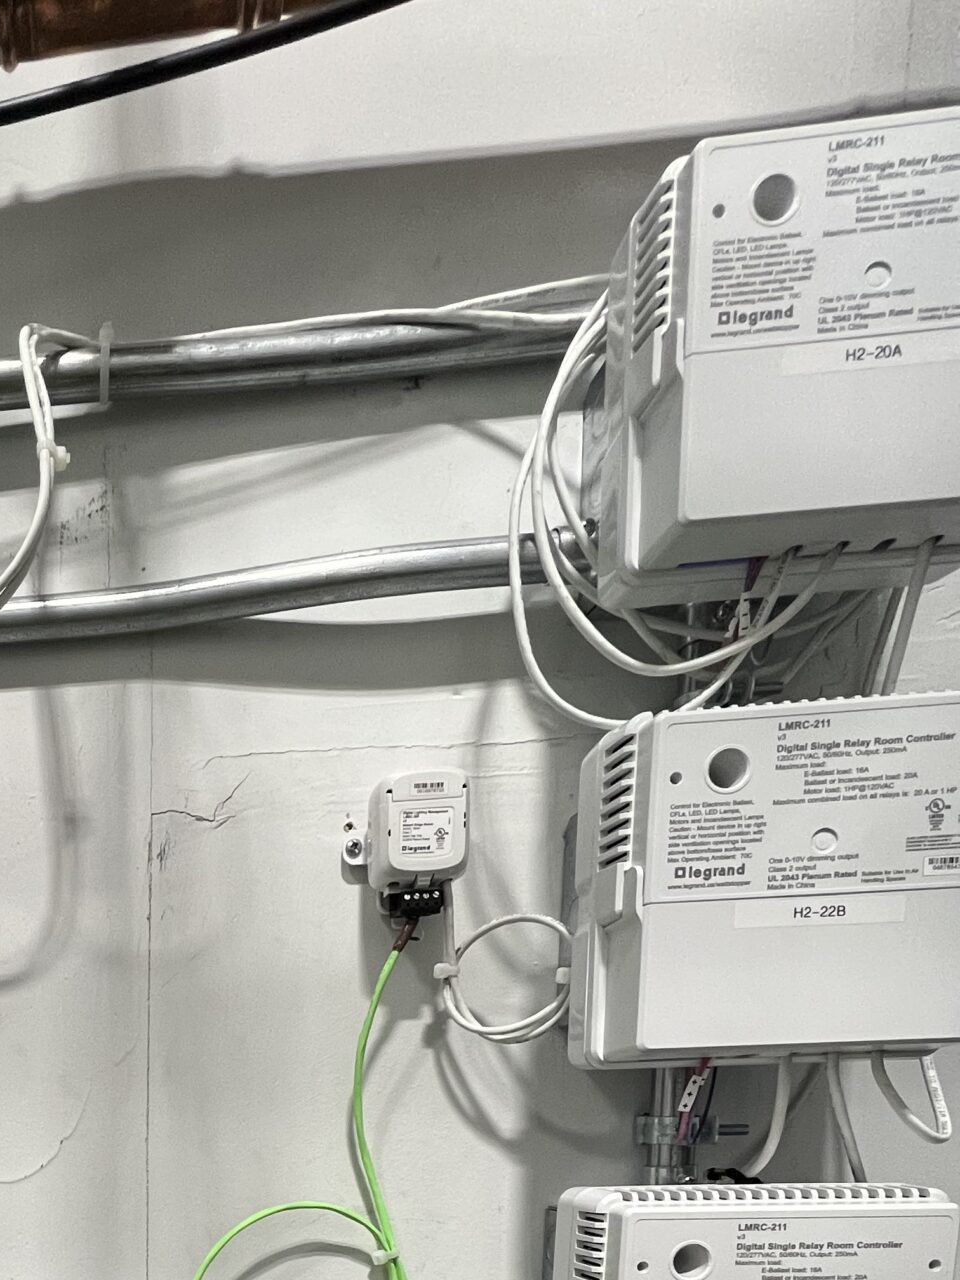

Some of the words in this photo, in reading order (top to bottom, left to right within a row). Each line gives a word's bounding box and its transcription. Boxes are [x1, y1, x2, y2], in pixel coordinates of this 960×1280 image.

[828, 135, 884, 152] LMRC-211
[827, 165, 860, 178] Digital
[862, 160, 895, 173] Single
[898, 158, 928, 168] Relay
[733, 304, 794, 326] legrand
[845, 344, 903, 361] H2-20A
[778, 719, 831, 731] LMRC-211
[777, 743, 808, 754] Digital
[811, 741, 840, 751] Single
[844, 739, 871, 748] Relay
[874, 737, 903, 746] Room
[906, 732, 956, 743] Controller
[689, 863, 745, 880] legrand
[794, 905, 846, 918] H2-22B
[738, 1223, 787, 1231] LMRC-211
[737, 1243, 765, 1251] Digital
[768, 1243, 796, 1251] Single
[799, 1242, 824, 1251] Relay
